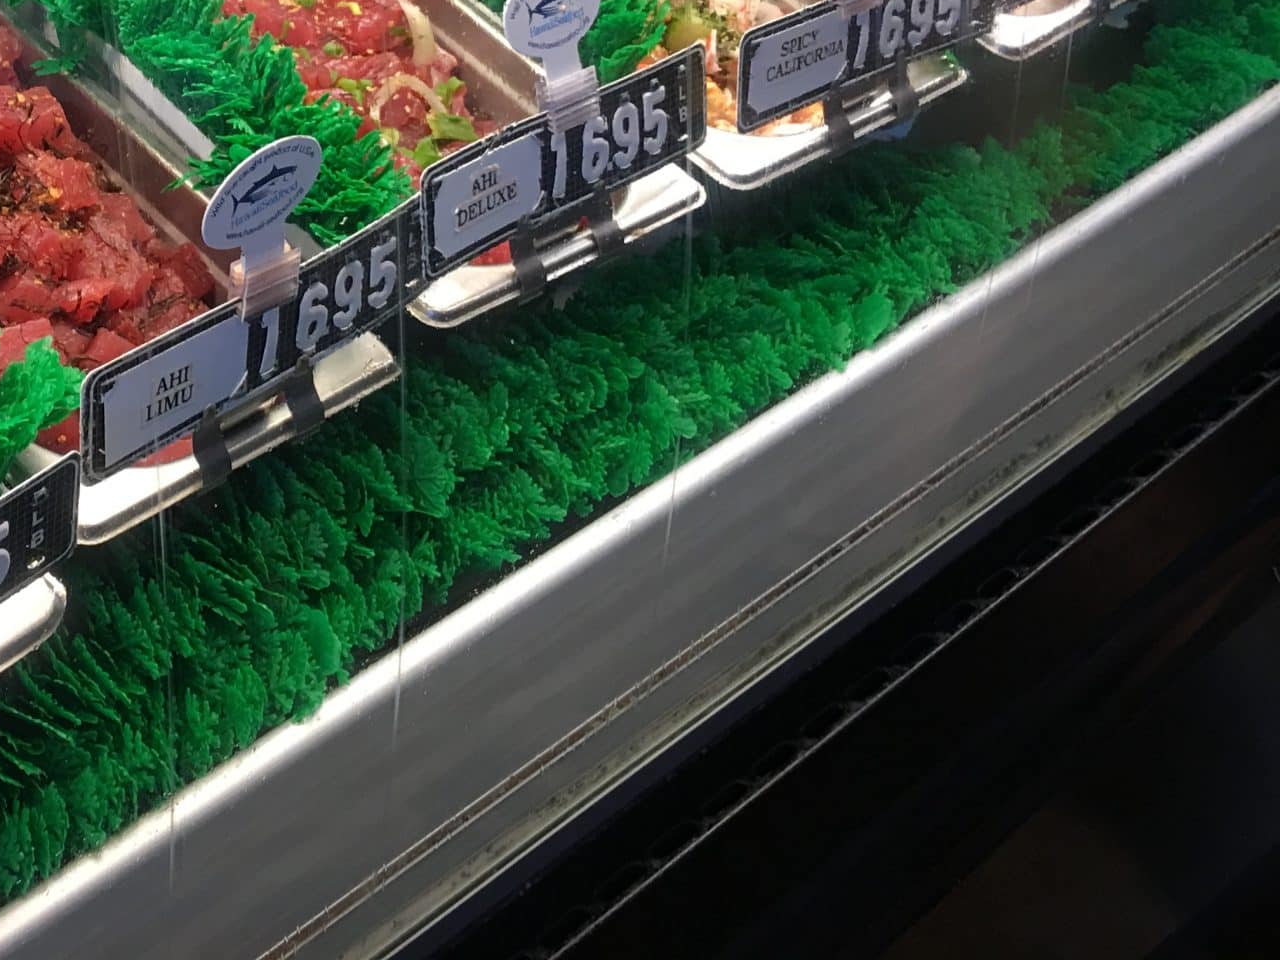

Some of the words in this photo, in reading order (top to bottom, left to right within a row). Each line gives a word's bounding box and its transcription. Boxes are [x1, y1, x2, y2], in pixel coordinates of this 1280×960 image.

[766, 39, 844, 83] CALIFORNIA
[780, 30, 819, 58] SPICY
[472, 170, 498, 196] AHI
[456, 182, 517, 229] DELUXE
[156, 365, 190, 396] AHI
[146, 383, 195, 422] LIMU
